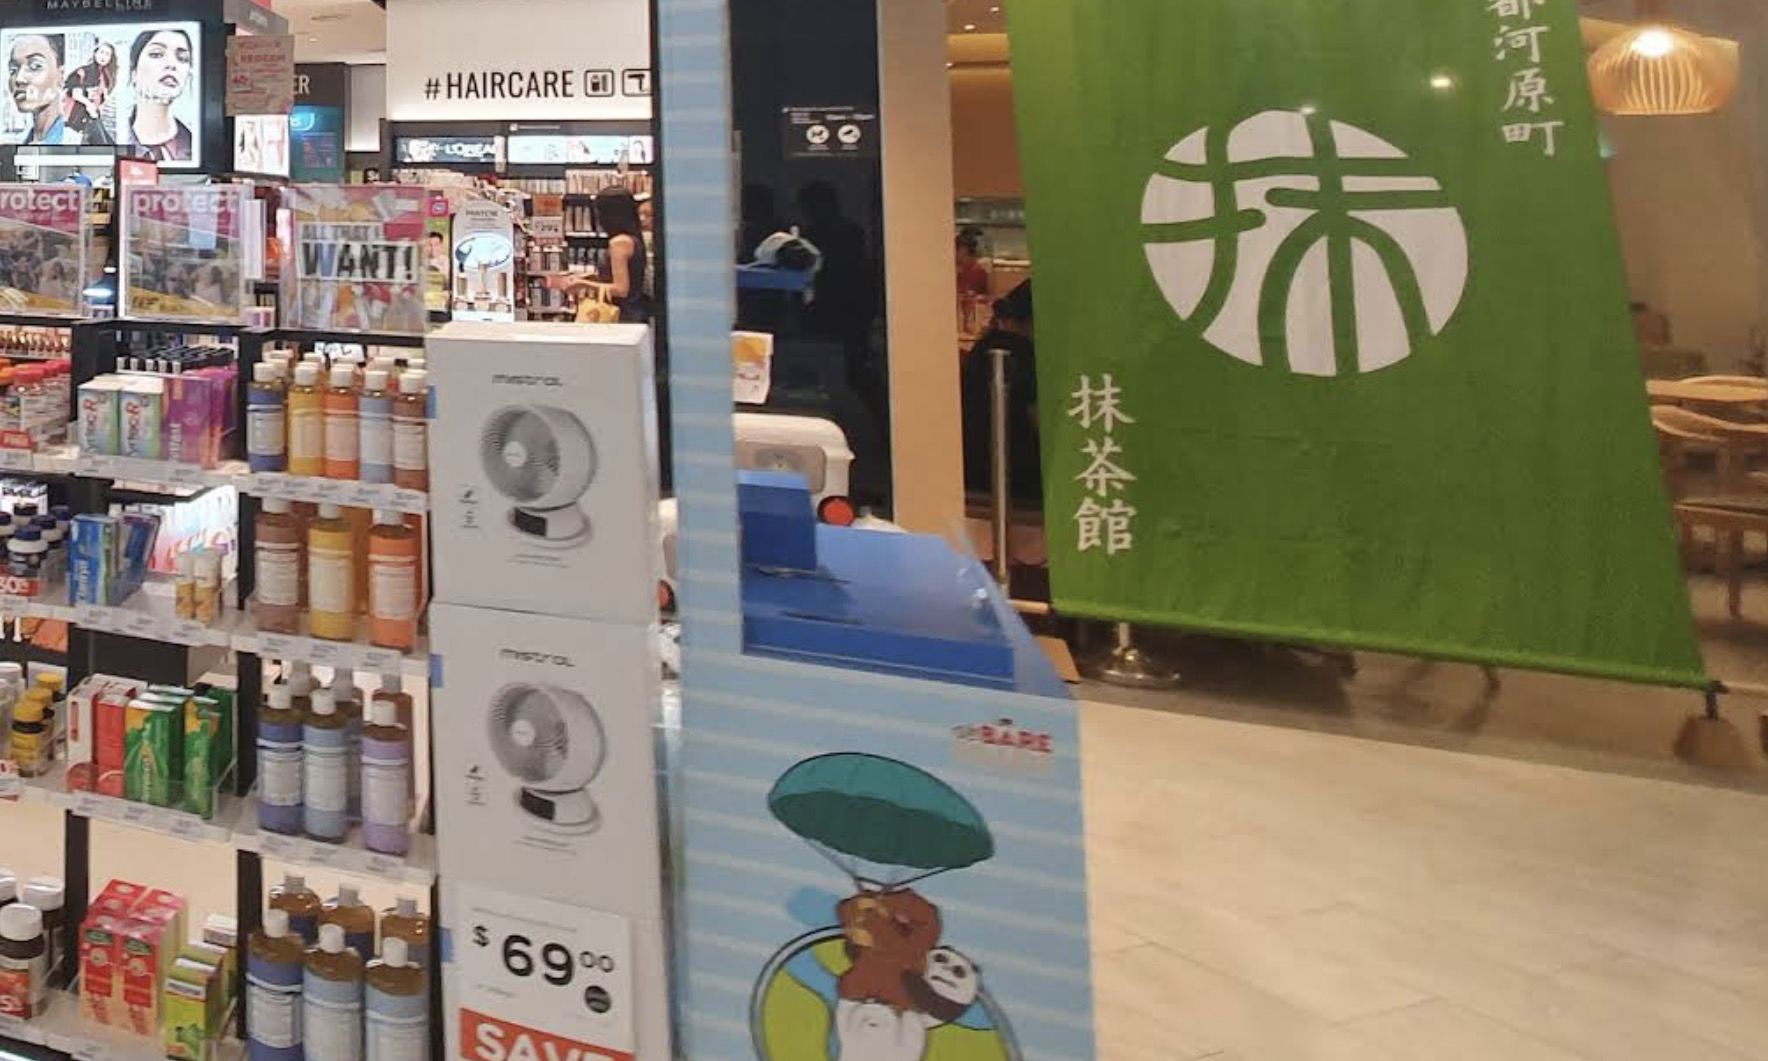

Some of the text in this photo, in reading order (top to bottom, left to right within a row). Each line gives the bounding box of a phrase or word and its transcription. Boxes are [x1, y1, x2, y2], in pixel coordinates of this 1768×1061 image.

[133, 191, 237, 216] protect
[302, 242, 413, 280] WANT!
[1067, 372, 1138, 555] 抹茶館
